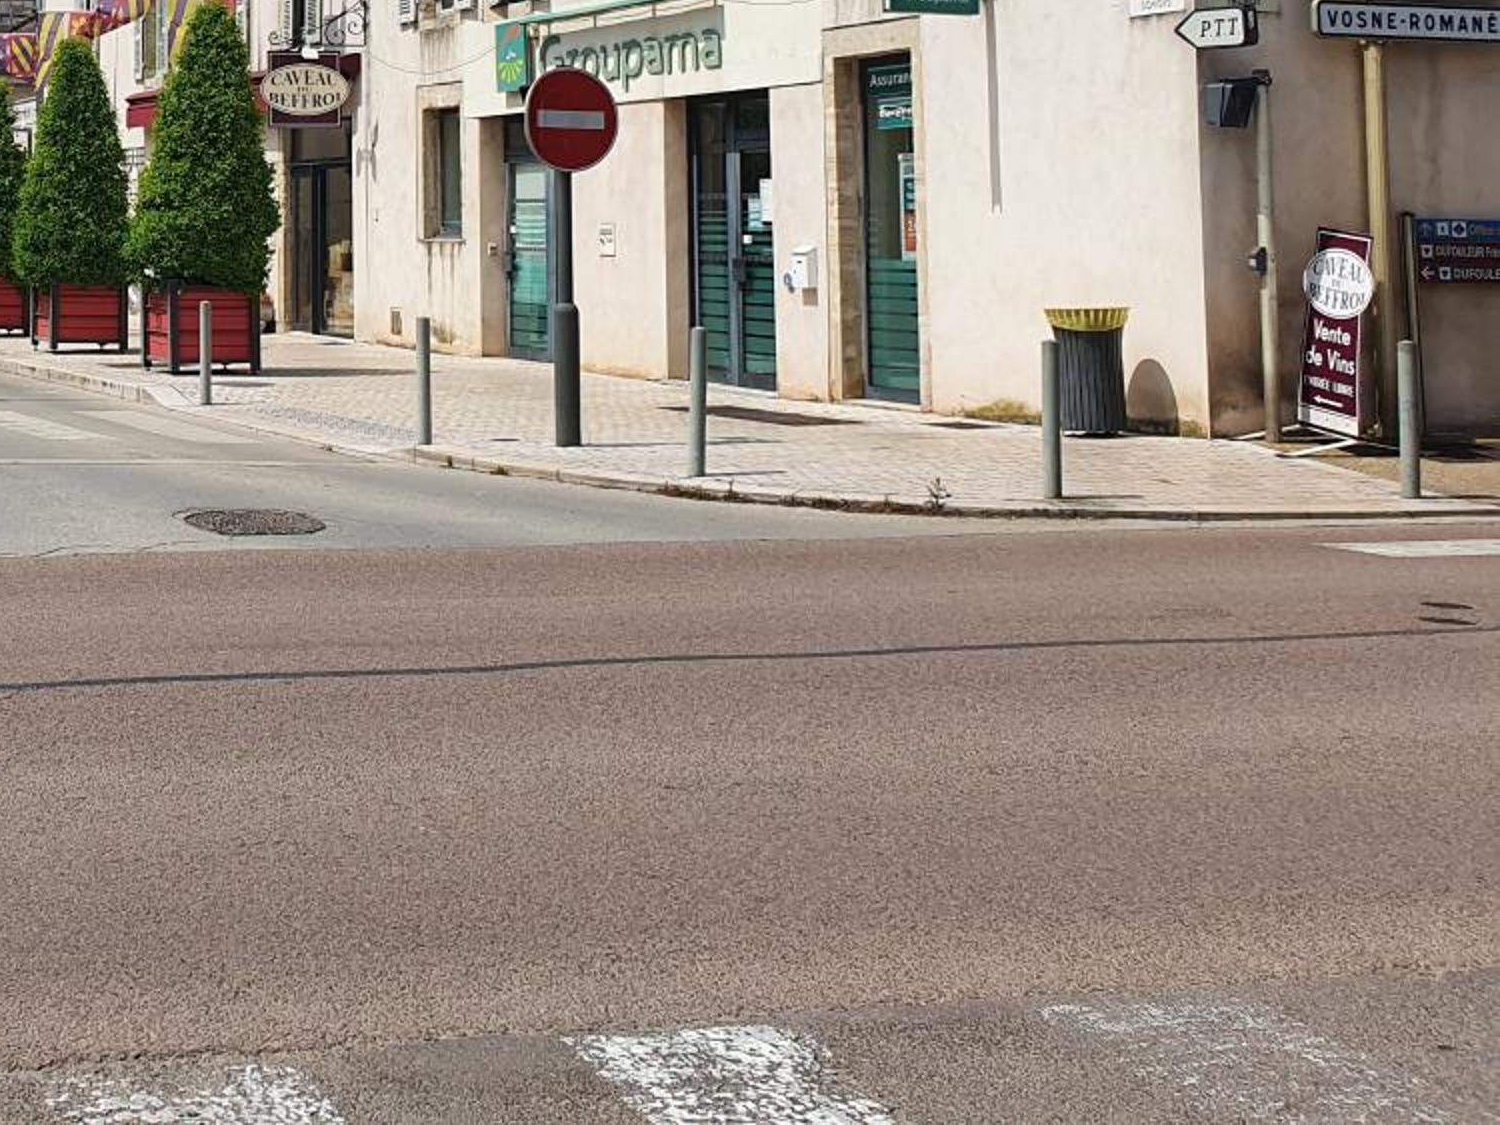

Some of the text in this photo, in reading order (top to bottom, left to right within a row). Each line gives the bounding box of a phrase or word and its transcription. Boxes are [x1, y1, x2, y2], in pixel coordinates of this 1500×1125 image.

[1326, 5, 1498, 34] VOSNE-ROMANÉ
[271, 70, 337, 86] CAVEAU
[269, 92, 341, 109] BEFFROI
[1313, 257, 1365, 284] CAVEAU
[1313, 318, 1351, 346] Vente
[1305, 344, 1355, 375] de Vins
